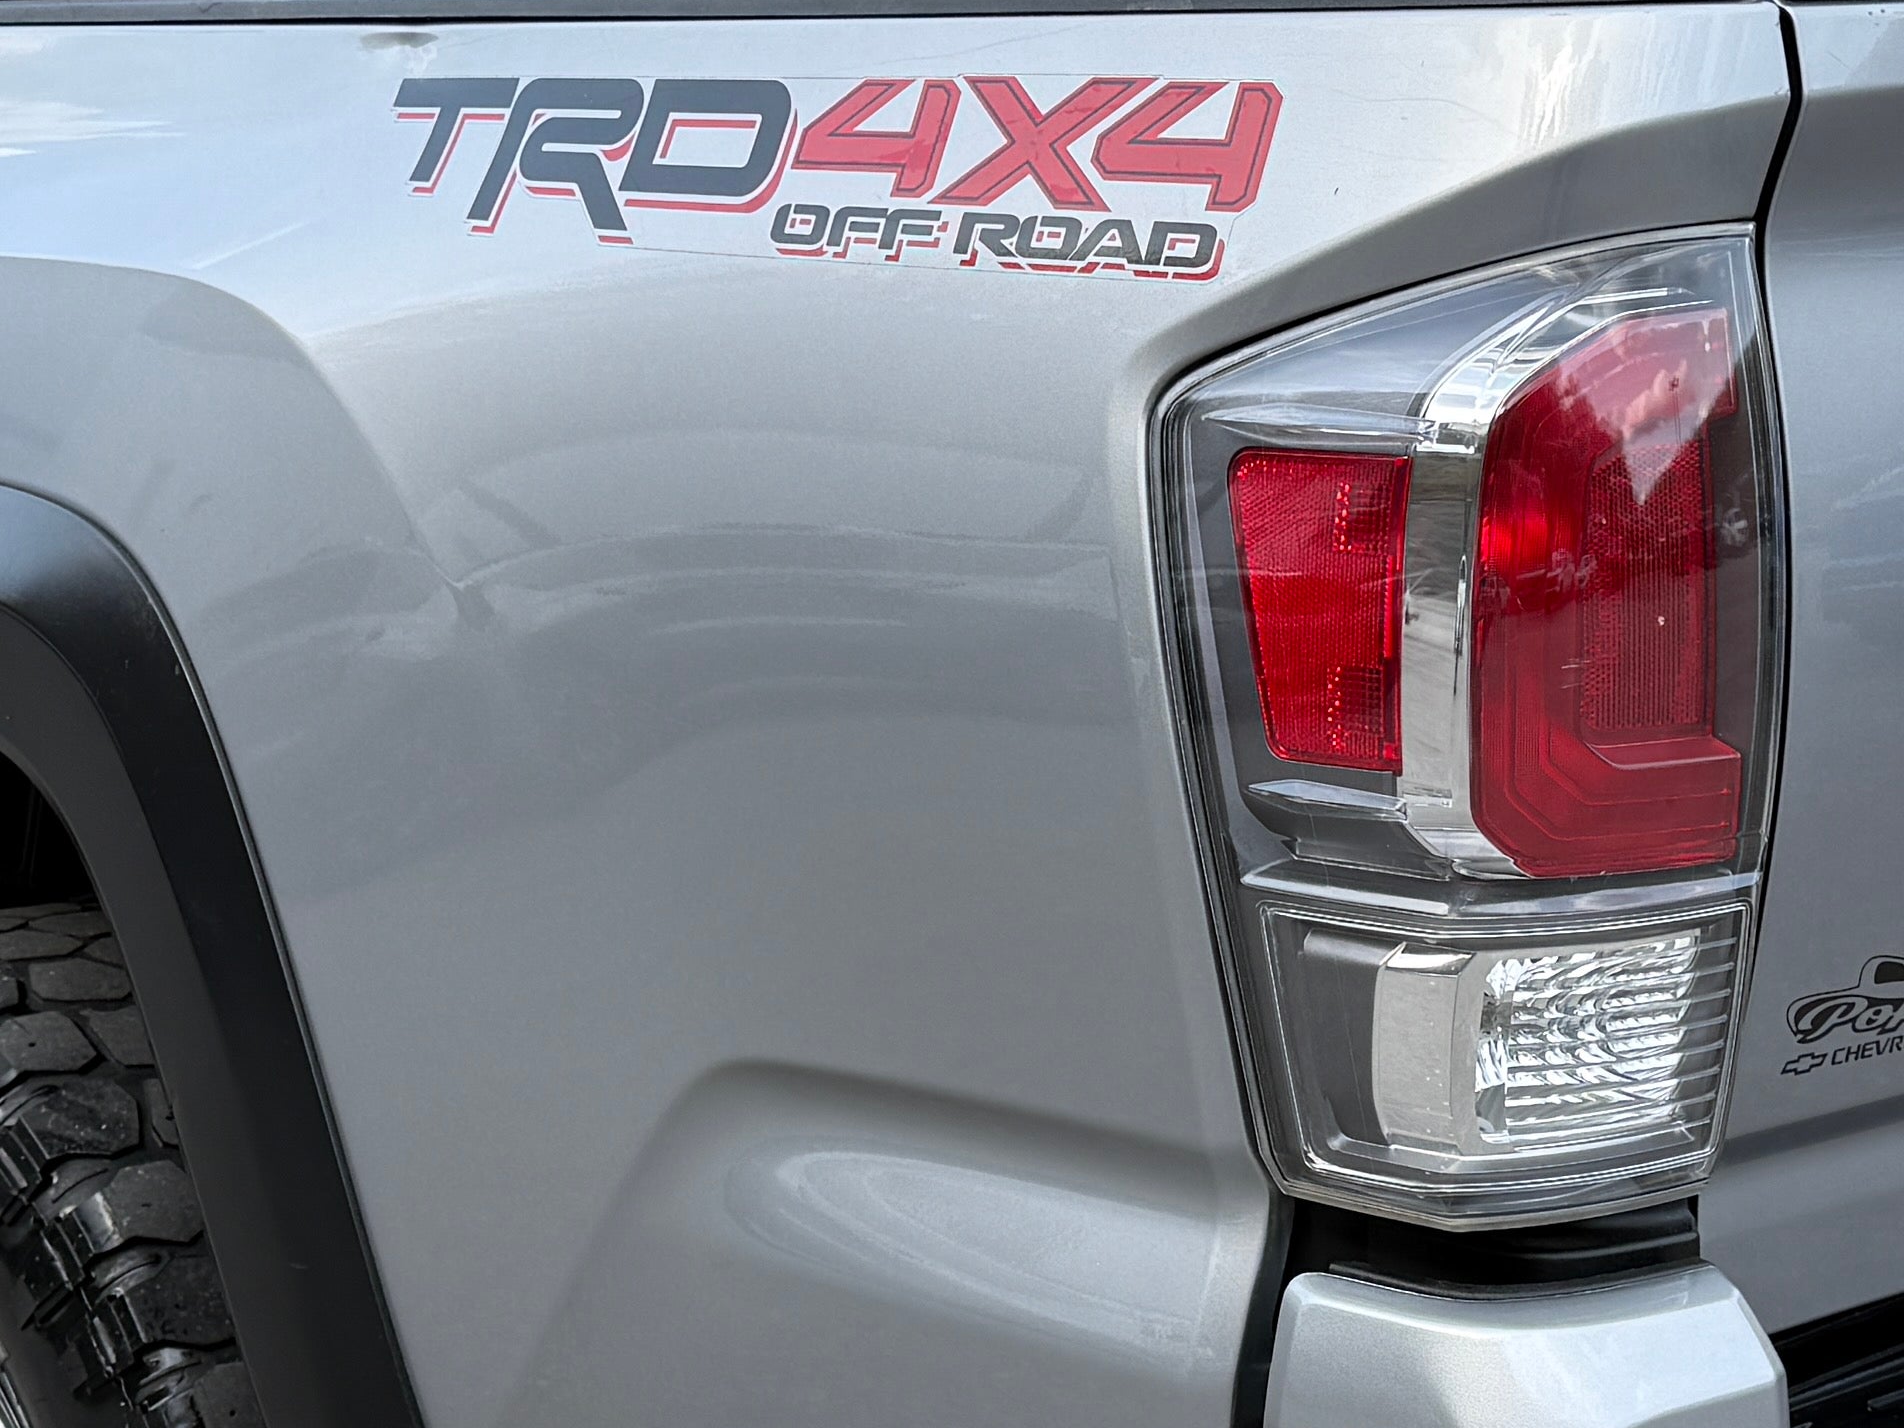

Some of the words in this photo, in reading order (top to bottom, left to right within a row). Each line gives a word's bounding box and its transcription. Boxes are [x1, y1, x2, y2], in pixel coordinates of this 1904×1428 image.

[392, 75, 798, 244] TRD
[768, 203, 946, 262] OFF
[952, 212, 1225, 281] ROAD
